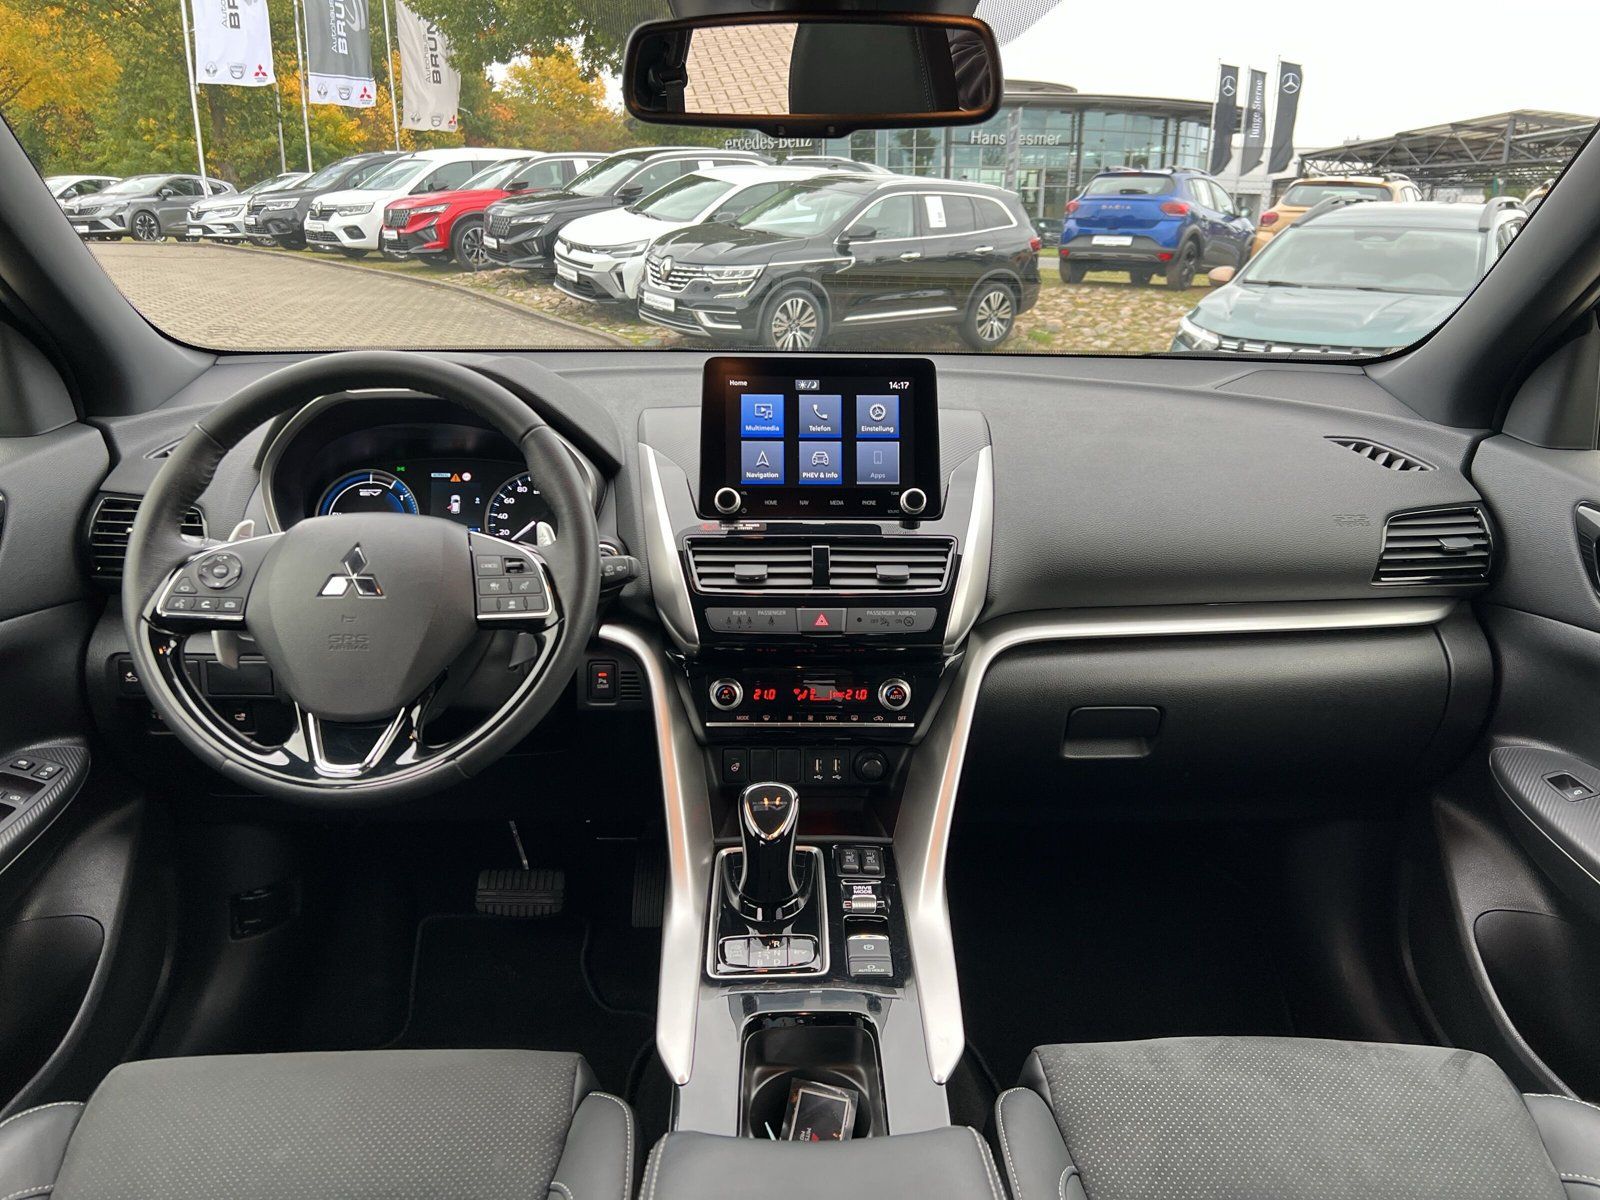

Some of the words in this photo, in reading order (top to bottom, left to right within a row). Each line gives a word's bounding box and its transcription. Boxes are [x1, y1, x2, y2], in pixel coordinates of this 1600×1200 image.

[335, 0, 348, 55] BRU
[1253, 80, 1264, 110] Sterne
[1250, 111, 1263, 138] Junge
[725, 133, 812, 150] ercedes-Benz
[970, 130, 1007, 145] Hans
[1019, 134, 1061, 145] esmer
[729, 379, 748, 387] Home
[889, 381, 910, 390] 14:17
[861, 425, 894, 433] Einstellung
[745, 471, 779, 479] Navigation
[753, 688, 776, 700] 21.0
